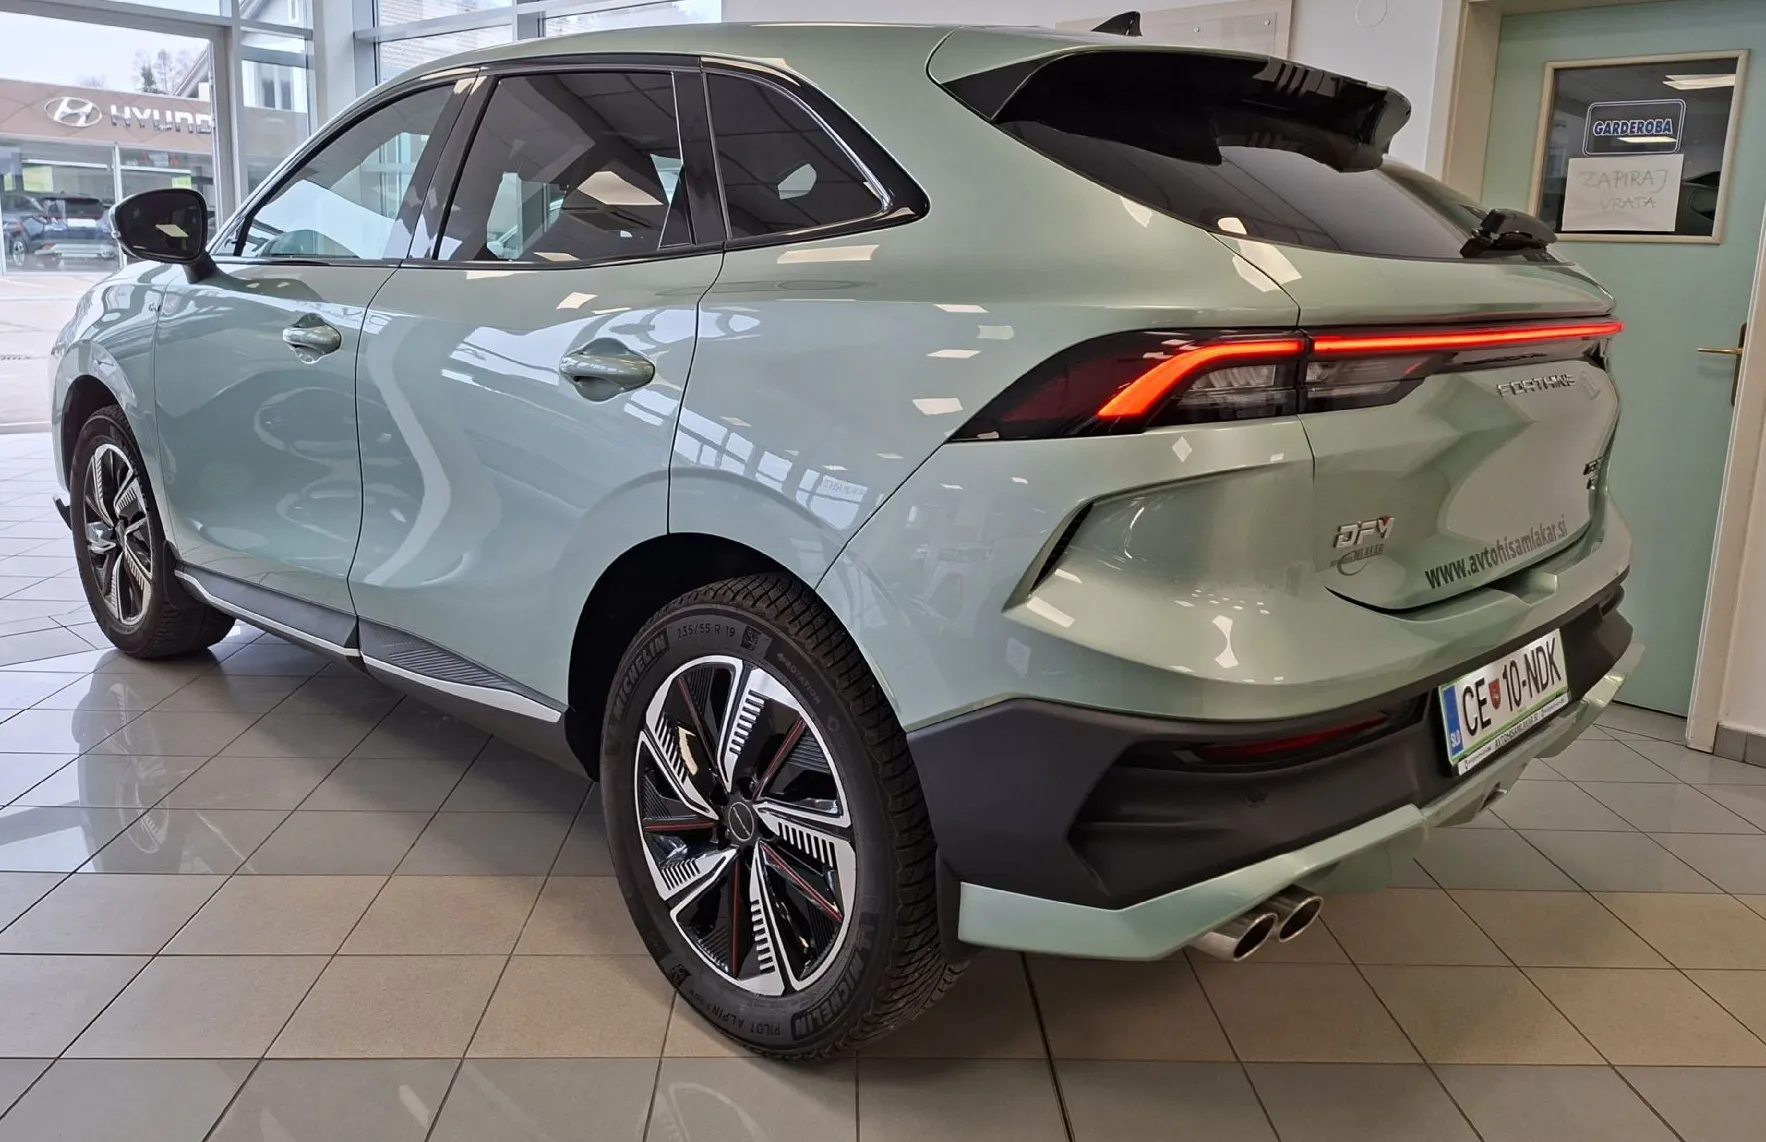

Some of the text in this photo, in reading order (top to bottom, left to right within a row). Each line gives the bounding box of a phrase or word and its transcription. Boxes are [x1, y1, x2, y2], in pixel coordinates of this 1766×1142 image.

[1593, 119, 1673, 136] GARDEROBA
[1580, 169, 1668, 194] ZAPIRAJ
[1600, 196, 1657, 210] VRATA
[1425, 515, 1568, 589] www.avtohisamlakar.si
[714, 625, 721, 635] R
[725, 625, 736, 638] 19
[1462, 637, 1562, 737] CE 10-NDK
[750, 1022, 781, 1036] PILOT
